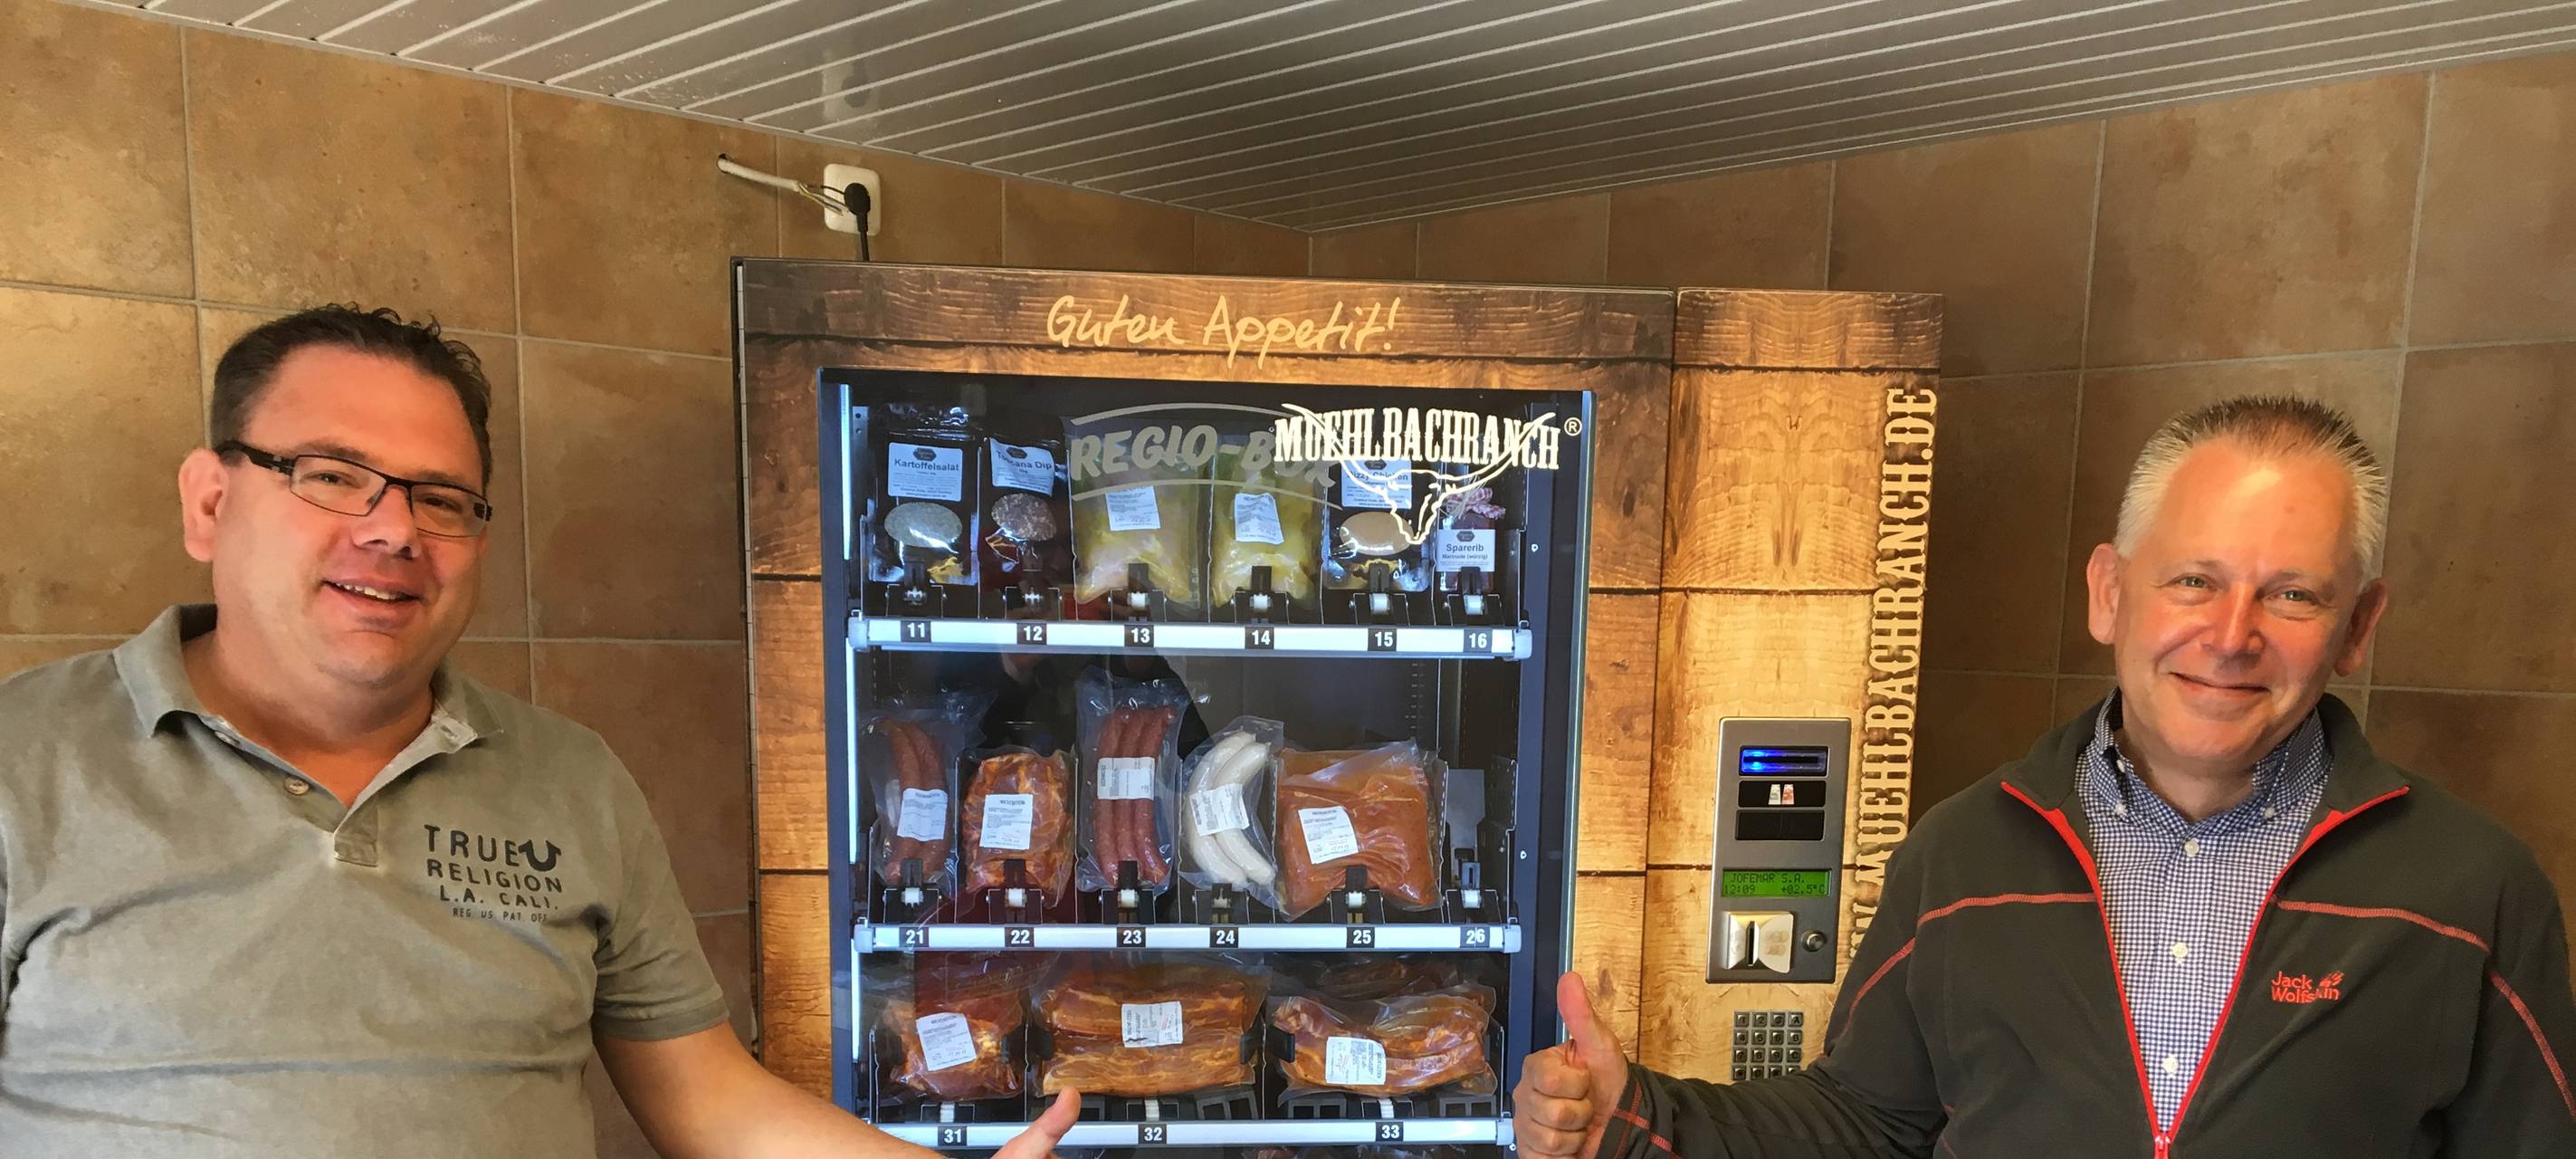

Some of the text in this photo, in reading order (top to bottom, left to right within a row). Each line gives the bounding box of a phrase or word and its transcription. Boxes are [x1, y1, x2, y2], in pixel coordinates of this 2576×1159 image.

[1046, 294, 1400, 369] Guten Appetit!
[1274, 407, 1561, 470] MUEHLBACHRANCH
[1071, 425, 1336, 487] REGIO-B
[894, 458, 959, 472] Kartoffelsalat
[1035, 461, 1052, 470] Dip
[1372, 472, 1408, 481] Chicen
[1445, 543, 1484, 553] Sparerib
[908, 623, 925, 637] 11
[1024, 626, 1043, 640] 12
[1131, 627, 1150, 643] 13
[1252, 630, 1271, 645] 14
[1375, 632, 1393, 647] 15
[1469, 633, 1488, 647] 16
[424, 824, 520, 867] TRUE
[427, 858, 563, 893] RELIGION
[1730, 873, 1805, 883] JOFEMAR S.A.
[1724, 884, 1756, 894] 12:09
[440, 885, 558, 911] L.A. CALI.
[453, 908, 472, 918] REG
[481, 910, 493, 919] US
[503, 911, 522, 921] PAT
[906, 930, 924, 943] 21
[1011, 930, 1029, 943] 22
[1123, 930, 1141, 943] 23
[1216, 930, 1235, 943] 24
[1353, 930, 1371, 943] 25
[1466, 930, 1485, 943] 26
[2270, 971, 2313, 990] Jack
[2271, 986, 2340, 1003] Wolfskin
[944, 1129, 962, 1143] 31
[1145, 1127, 1163, 1141] 32
[1382, 1125, 1400, 1138] 33
